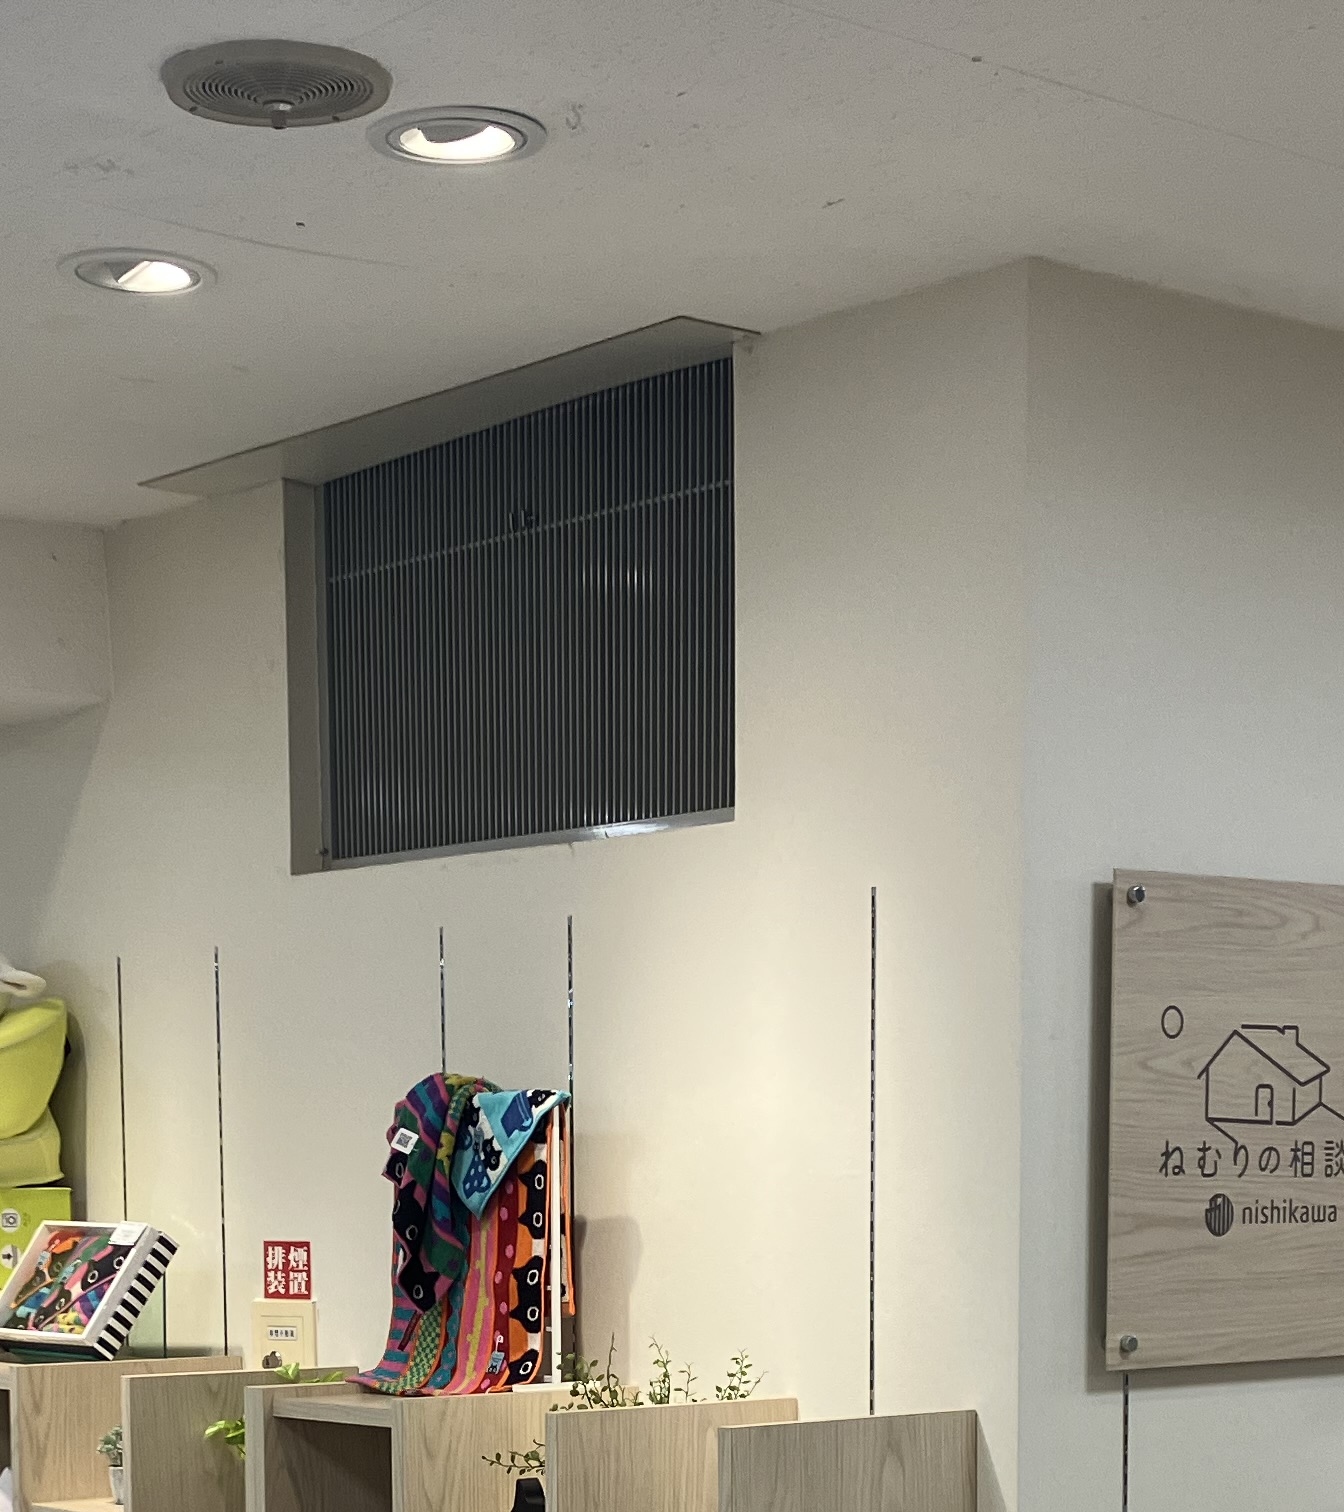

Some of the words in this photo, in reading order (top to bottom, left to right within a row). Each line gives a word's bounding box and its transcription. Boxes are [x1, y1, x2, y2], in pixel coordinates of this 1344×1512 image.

[1241, 1199, 1338, 1226] nishikawa
[266, 1246, 308, 1270] 排煙
[266, 1271, 308, 1295] 装置
